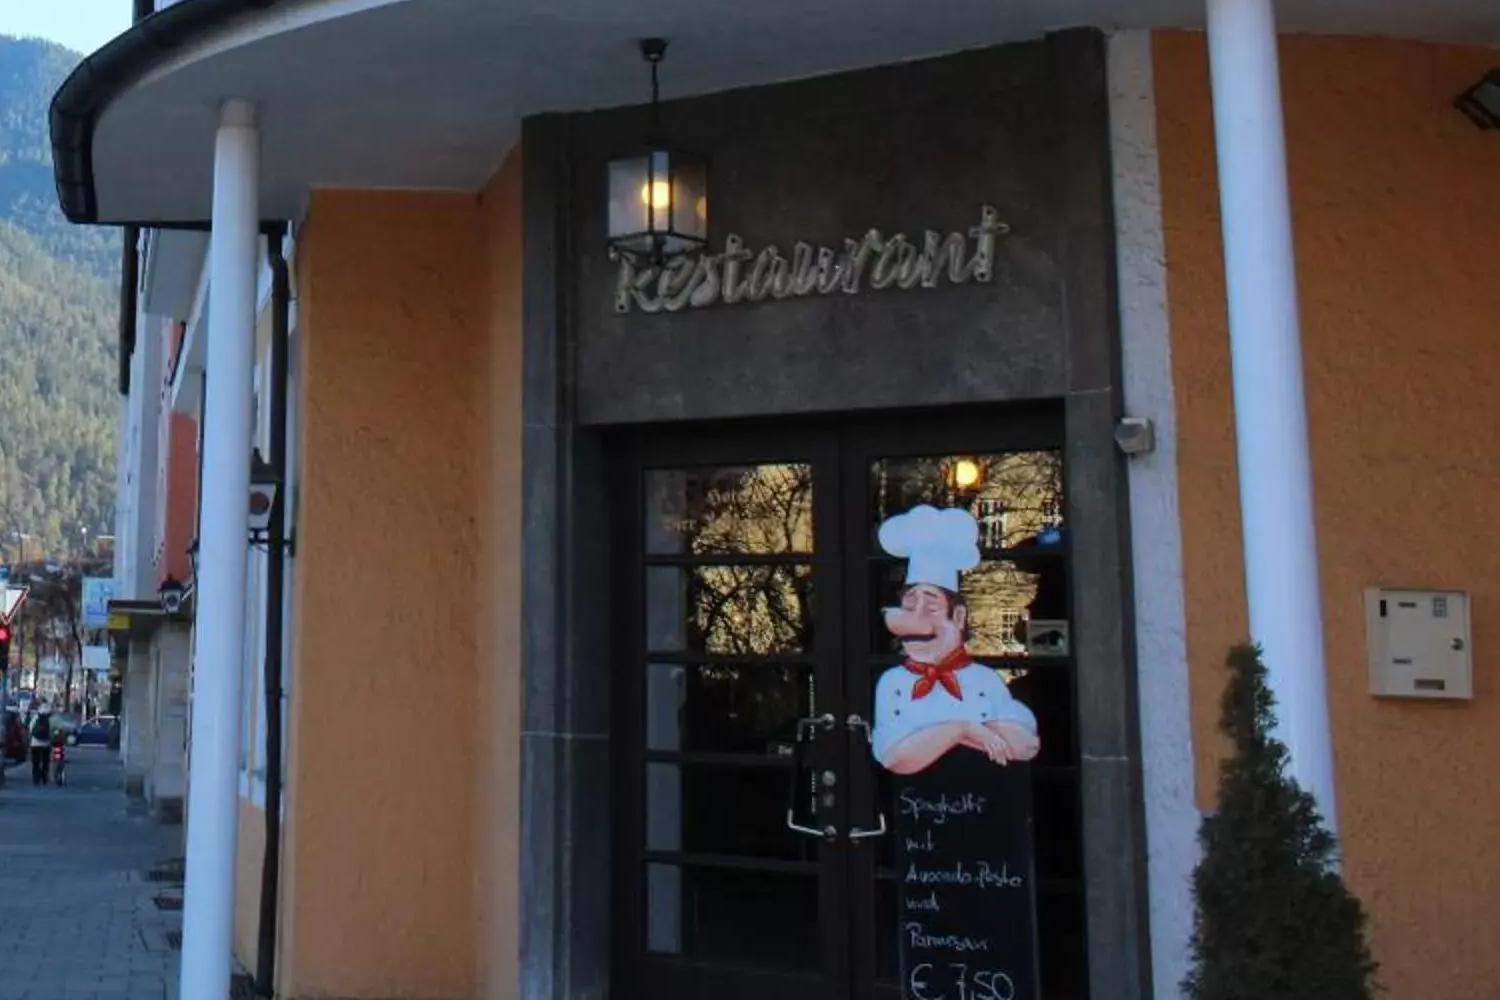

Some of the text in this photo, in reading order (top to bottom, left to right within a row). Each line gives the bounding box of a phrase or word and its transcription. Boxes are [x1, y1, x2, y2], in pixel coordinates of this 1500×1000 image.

[610, 204, 1009, 313] Restaurant
[900, 786, 987, 824] Spaghetti
[906, 829, 935, 851] mit
[906, 891, 940, 912] und
[906, 922, 989, 952] Parmesan
